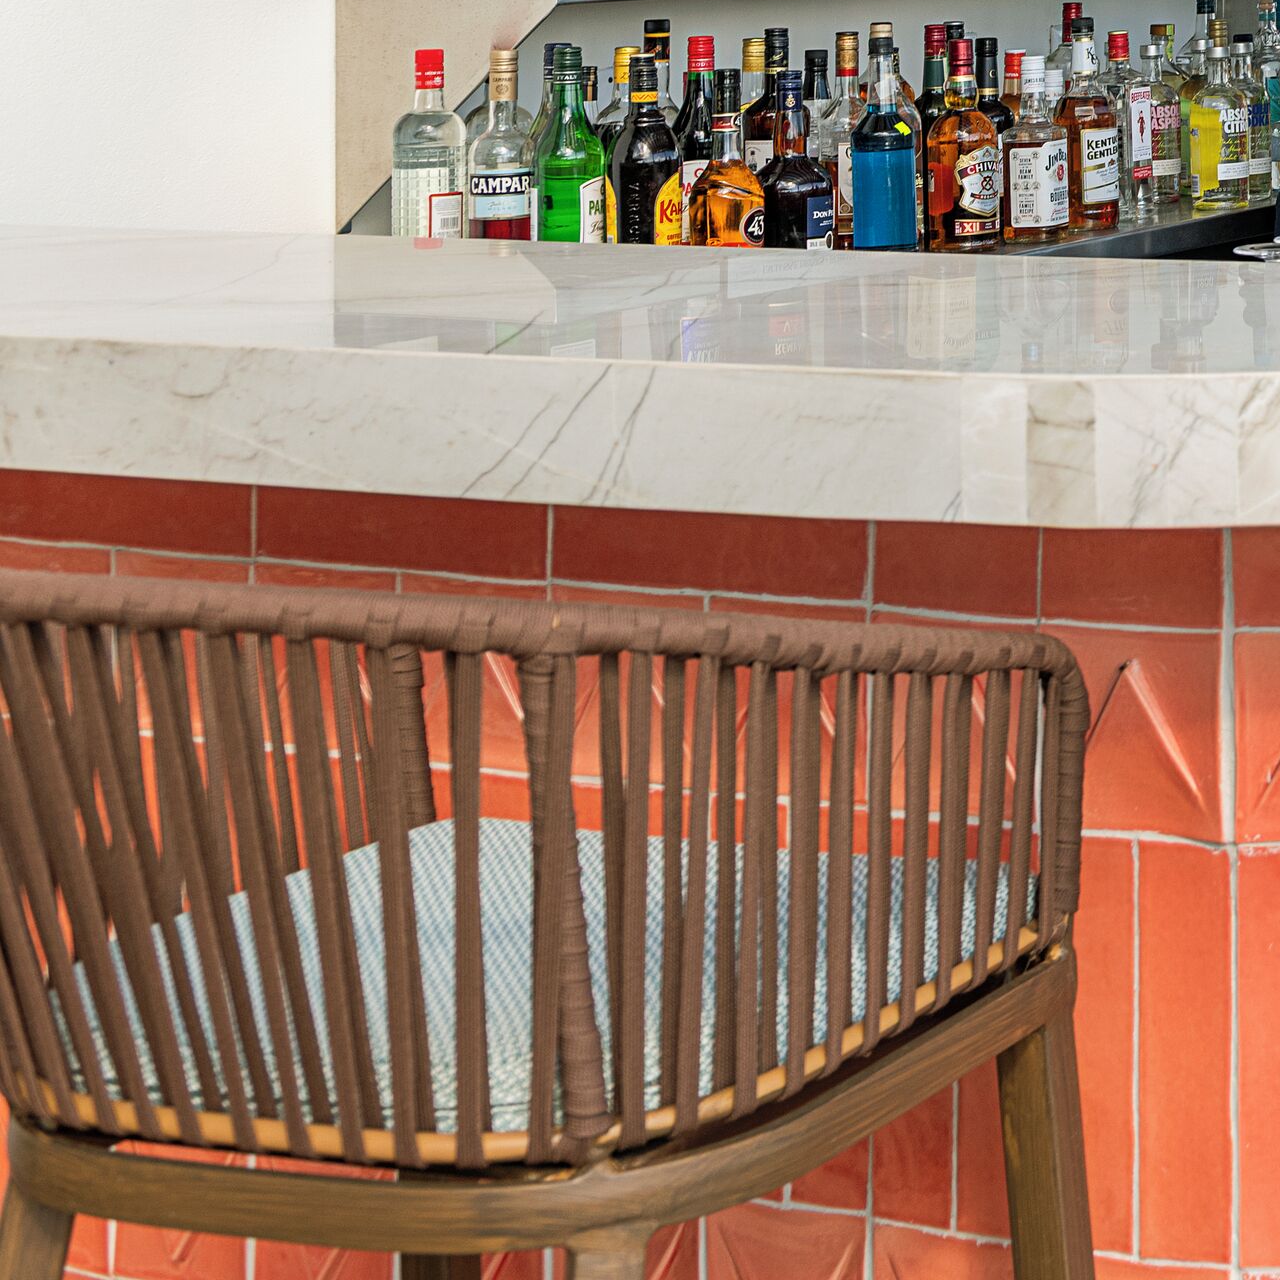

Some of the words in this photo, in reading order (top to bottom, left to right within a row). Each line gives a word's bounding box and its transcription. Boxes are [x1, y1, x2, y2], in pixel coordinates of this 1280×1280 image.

[556, 73, 578, 81] ITALY
[1045, 154, 1058, 171] JIM
[471, 175, 530, 194] CAMPAR
[813, 210, 828, 219] DON
[749, 215, 765, 236] 43
[963, 221, 980, 233] XII
